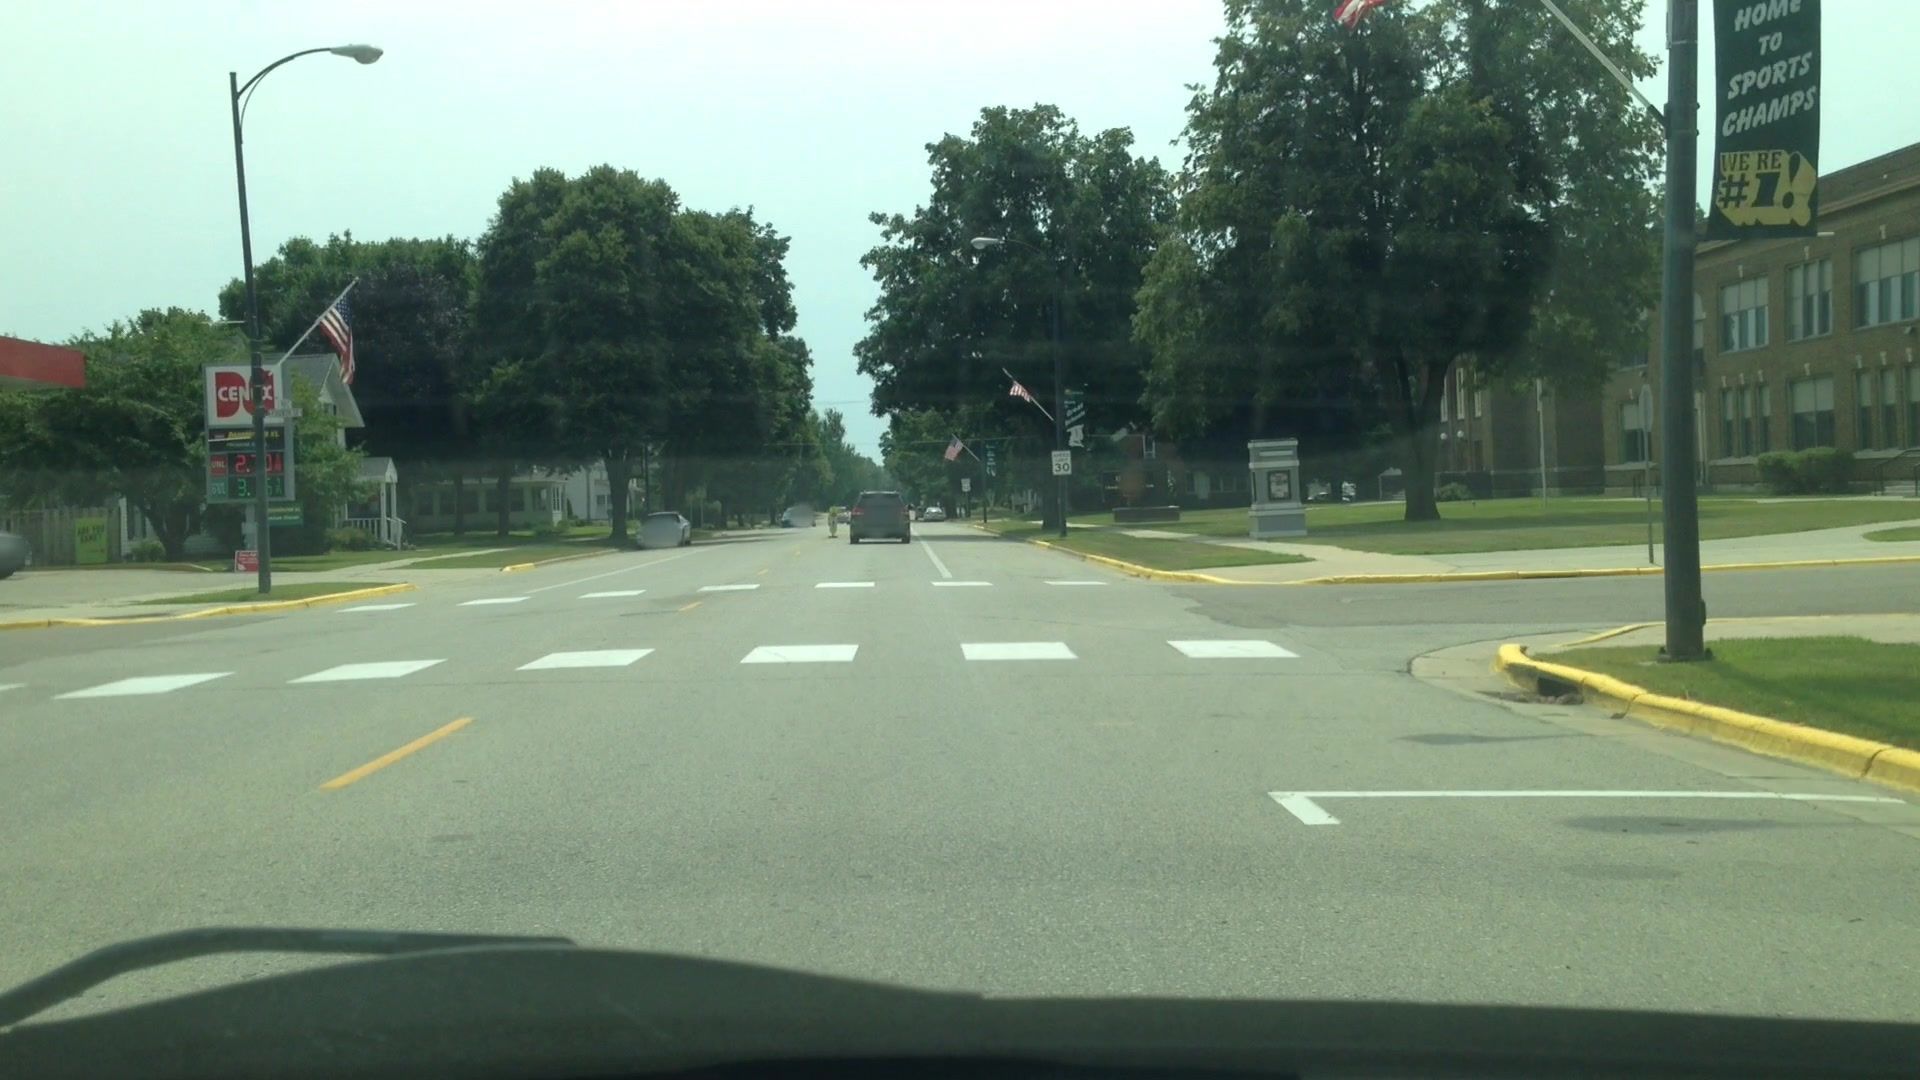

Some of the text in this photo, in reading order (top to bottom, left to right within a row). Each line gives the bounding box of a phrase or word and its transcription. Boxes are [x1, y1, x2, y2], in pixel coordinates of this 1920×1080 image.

[1734, 0, 1801, 32] HOME
[1758, 31, 1783, 55] TO
[1727, 51, 1813, 100] SPORTS
[1722, 85, 1817, 137] CHAMPS
[218, 385, 273, 402] CENX
[1055, 462, 1070, 472] 30
